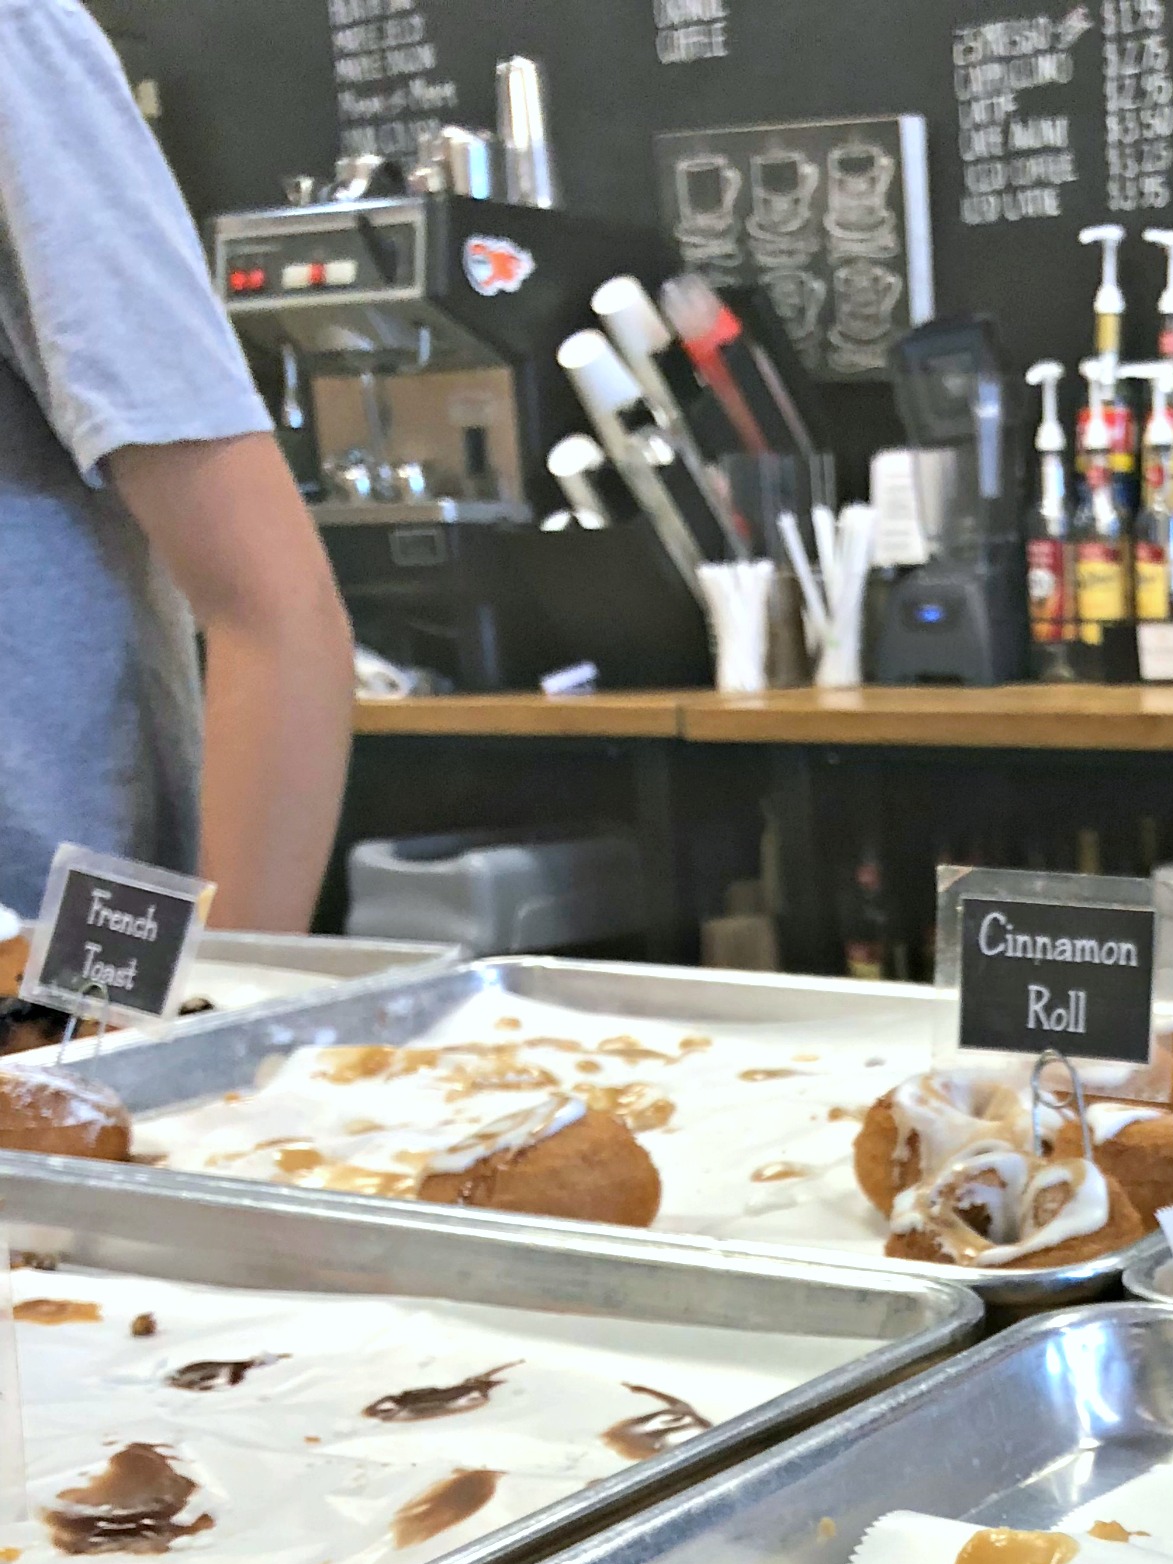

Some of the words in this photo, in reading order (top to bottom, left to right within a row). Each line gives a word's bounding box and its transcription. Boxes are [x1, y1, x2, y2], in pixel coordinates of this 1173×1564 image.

[87, 888, 158, 942] French
[979, 911, 1139, 968] Cinnamon
[82, 941, 138, 990] Toast
[1026, 983, 1087, 1034] Roll
